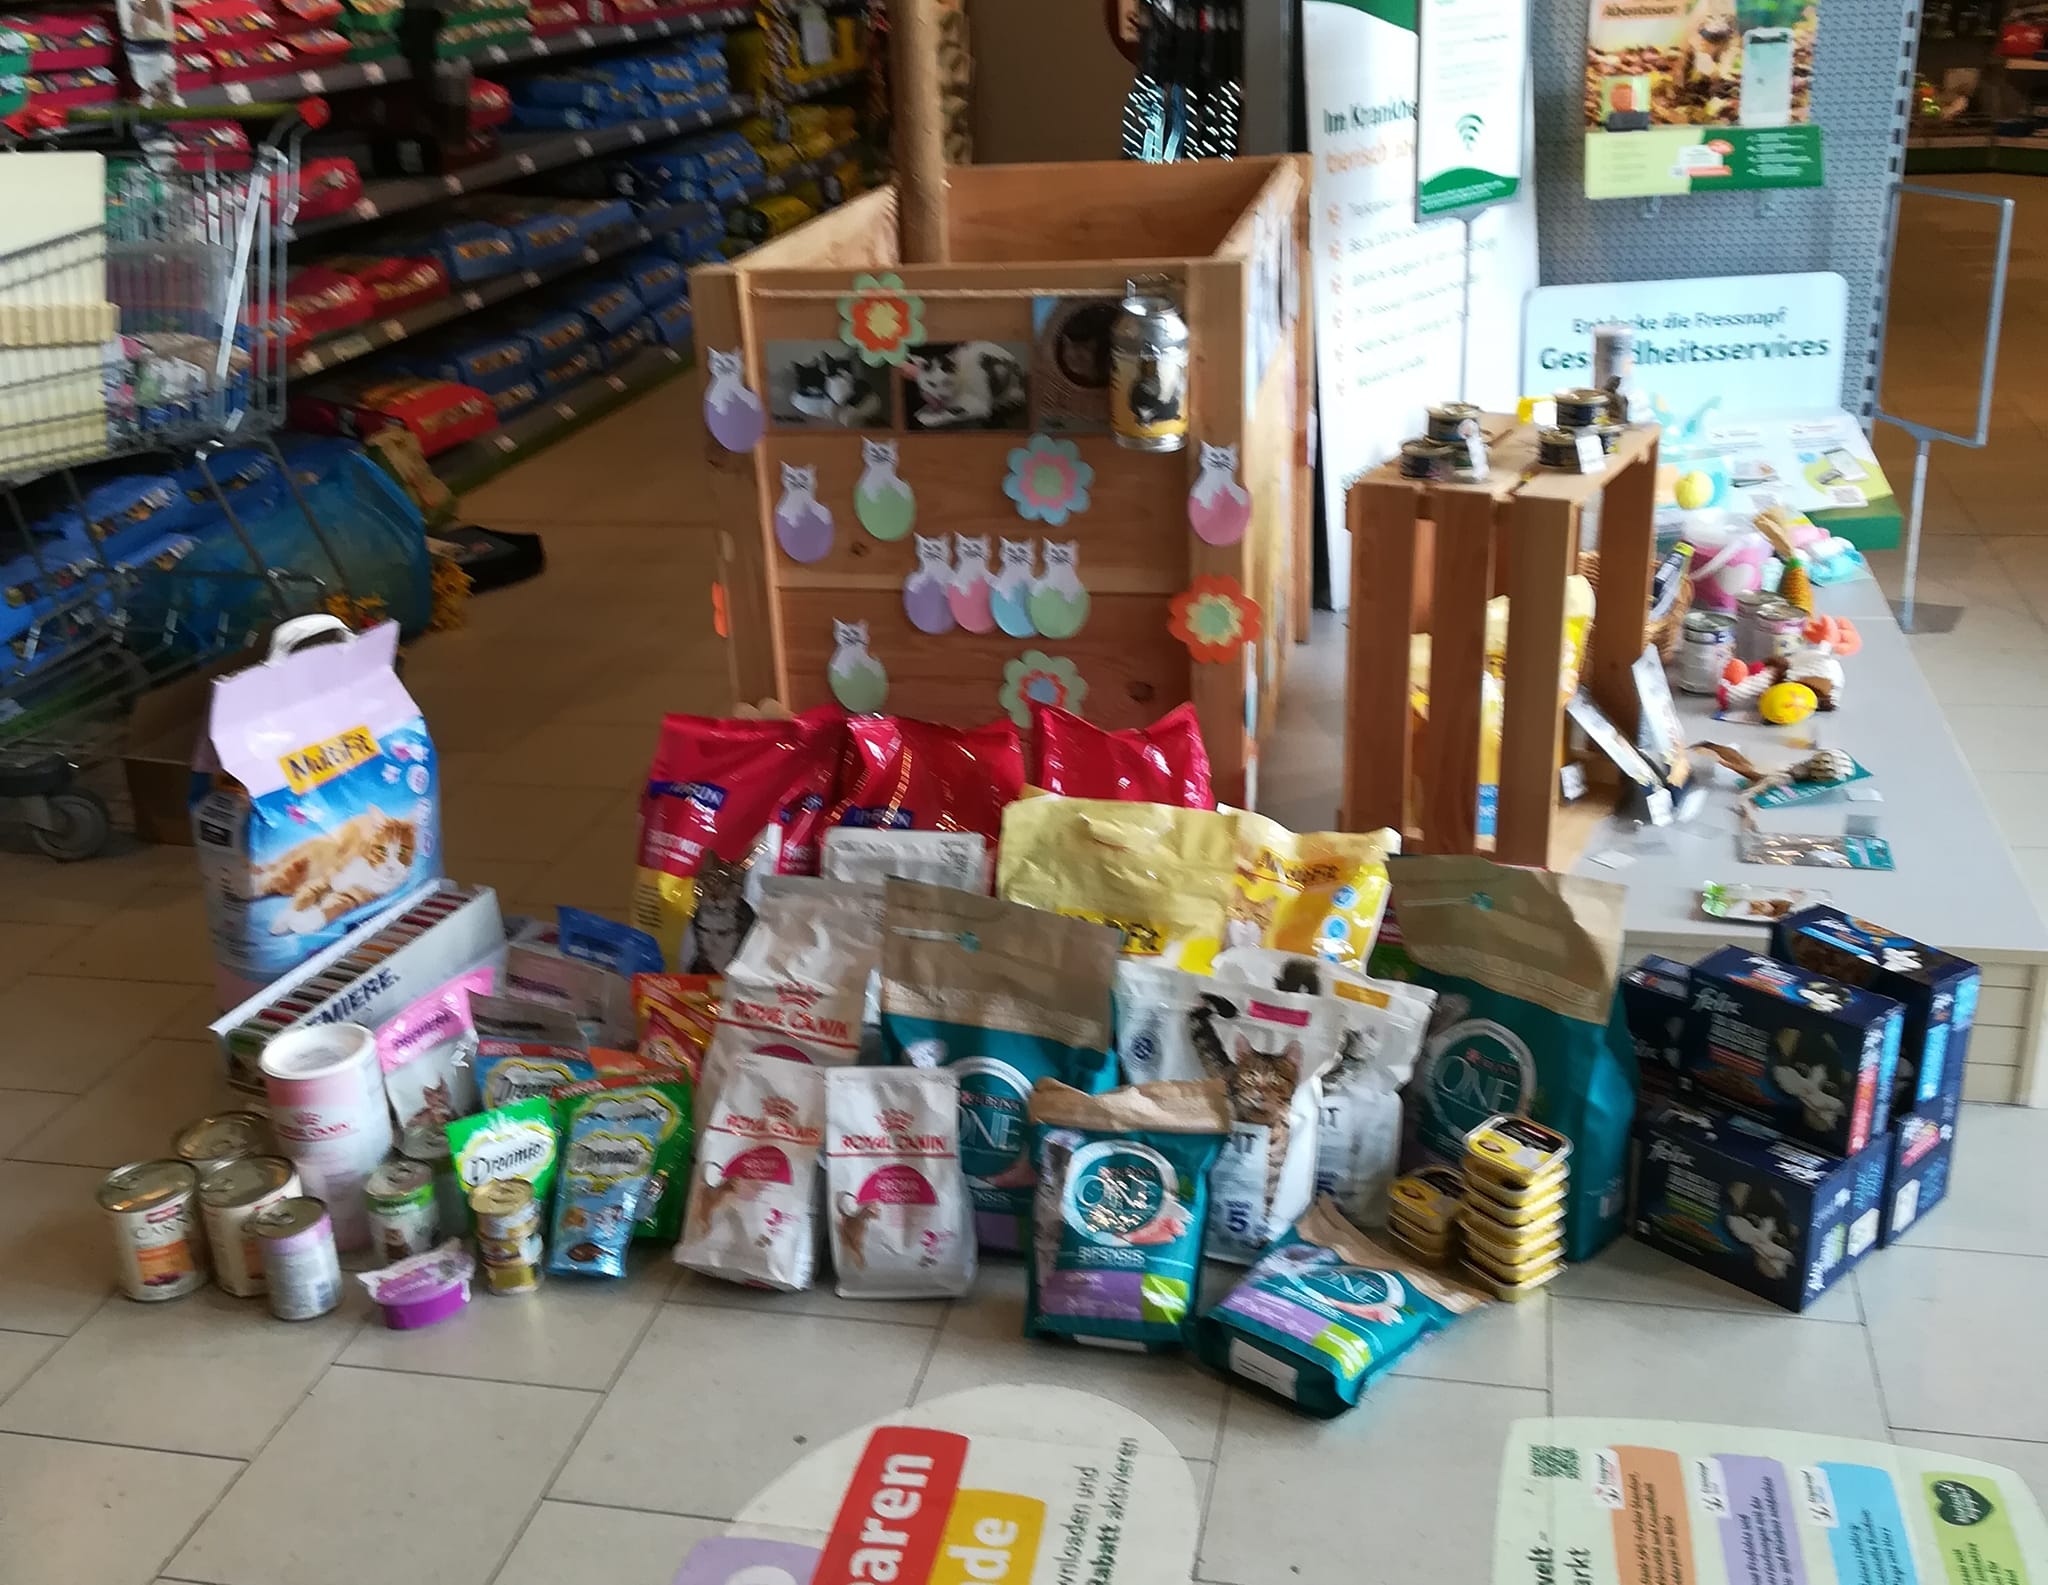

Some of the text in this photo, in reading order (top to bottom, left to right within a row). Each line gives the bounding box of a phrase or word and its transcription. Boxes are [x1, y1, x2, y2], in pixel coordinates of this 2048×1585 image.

[1540, 334, 1831, 370] Gesdheitsservices
[1074, 1464, 1100, 1501] und
[846, 1453, 935, 1585] aren
[946, 1517, 1020, 1585] de
